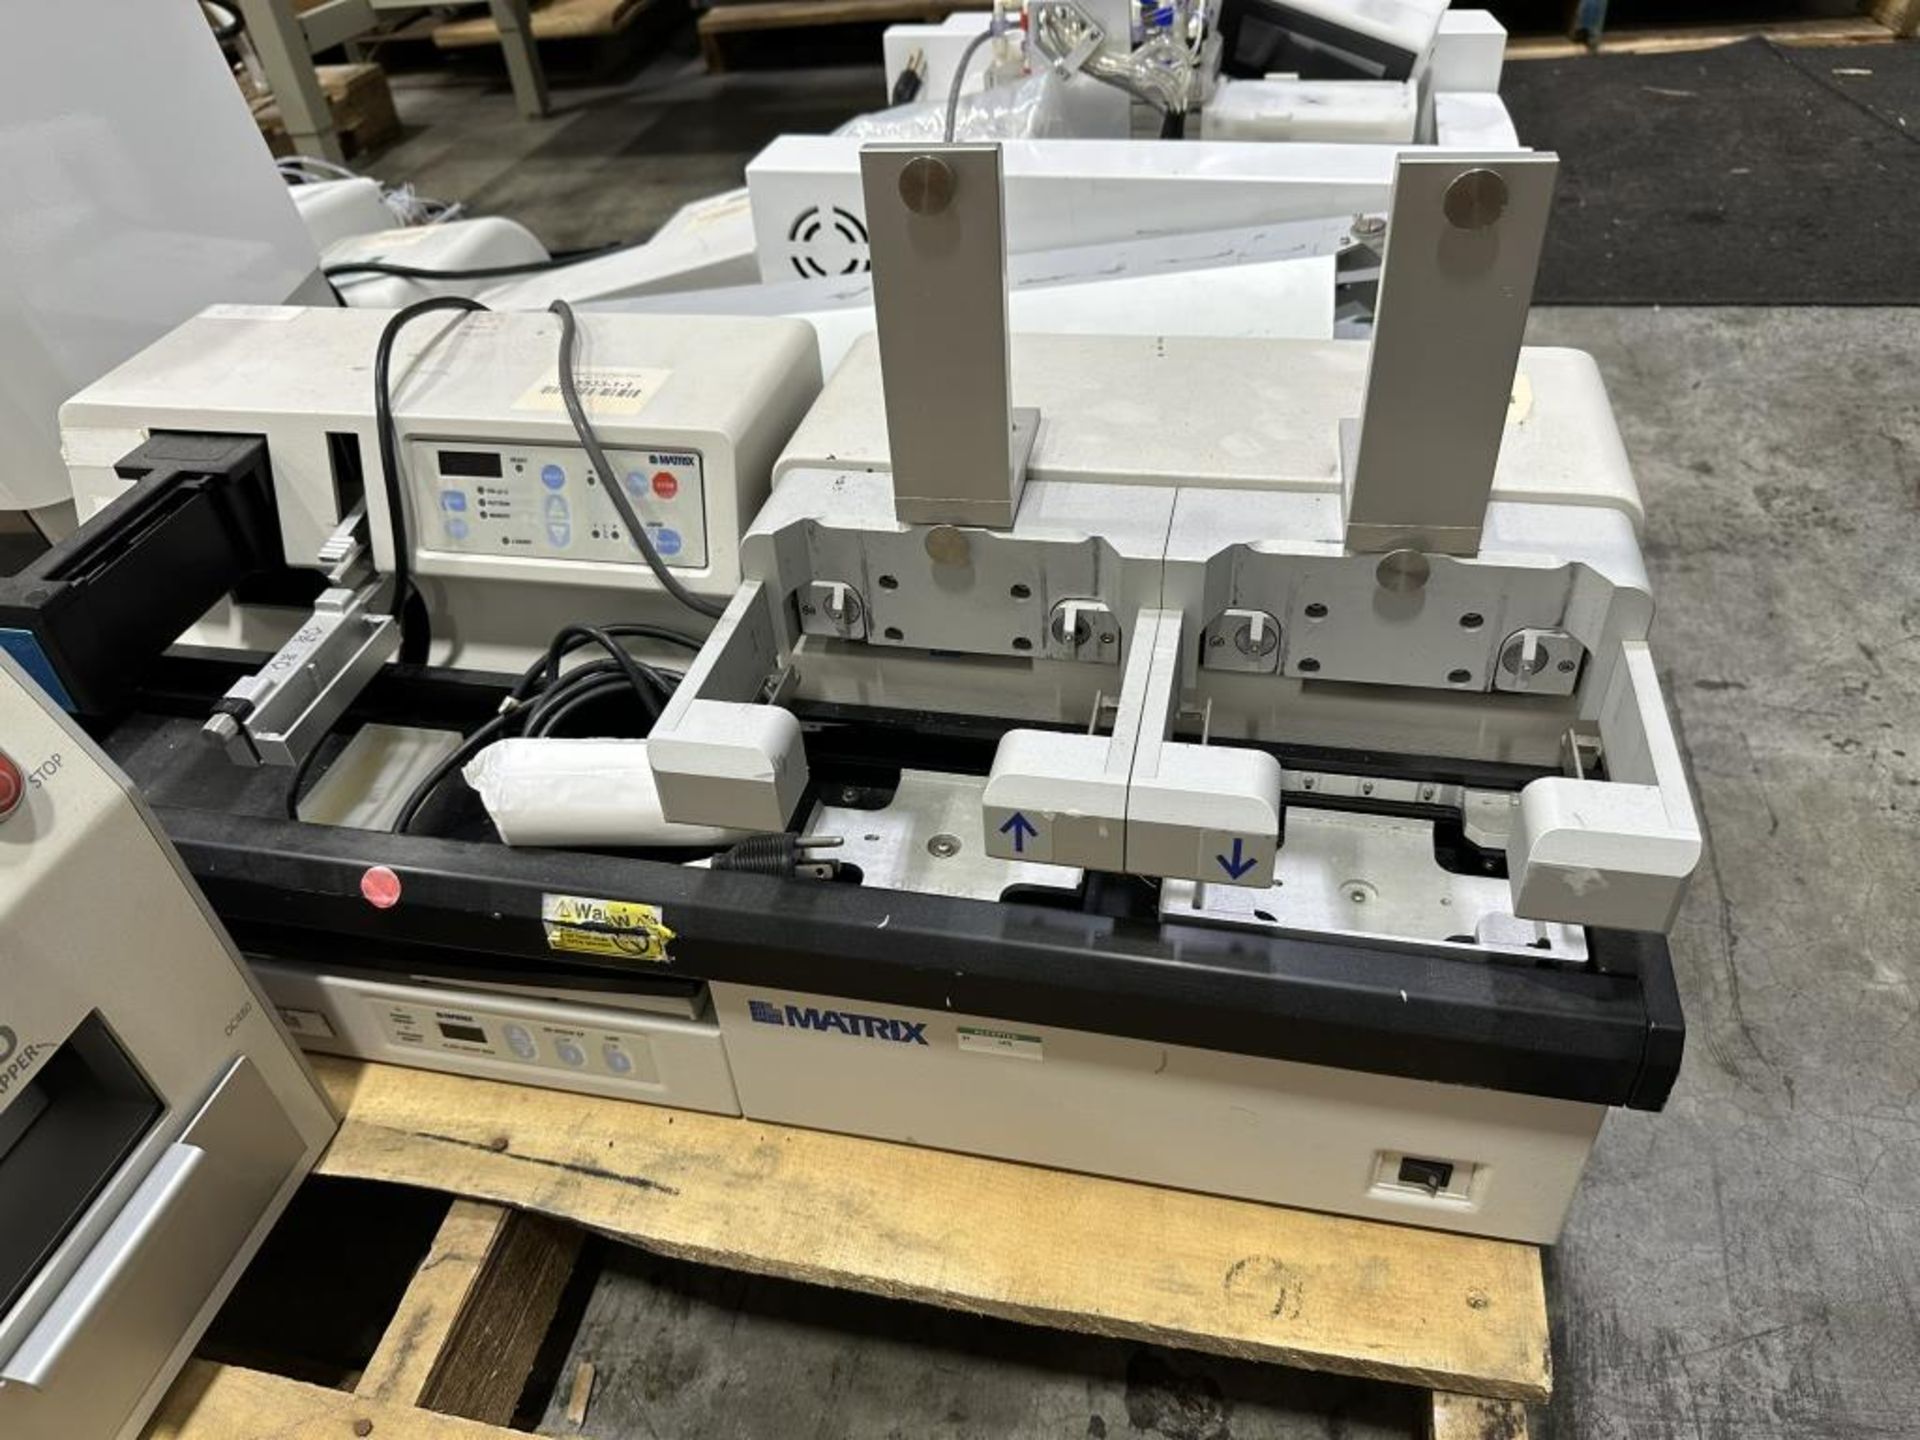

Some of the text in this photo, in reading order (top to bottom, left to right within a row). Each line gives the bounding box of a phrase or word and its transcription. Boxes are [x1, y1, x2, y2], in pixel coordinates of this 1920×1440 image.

[28, 753, 63, 789] STOP
[784, 1004, 929, 1045] MATRIX
[0, 1045, 39, 1094] PPER
